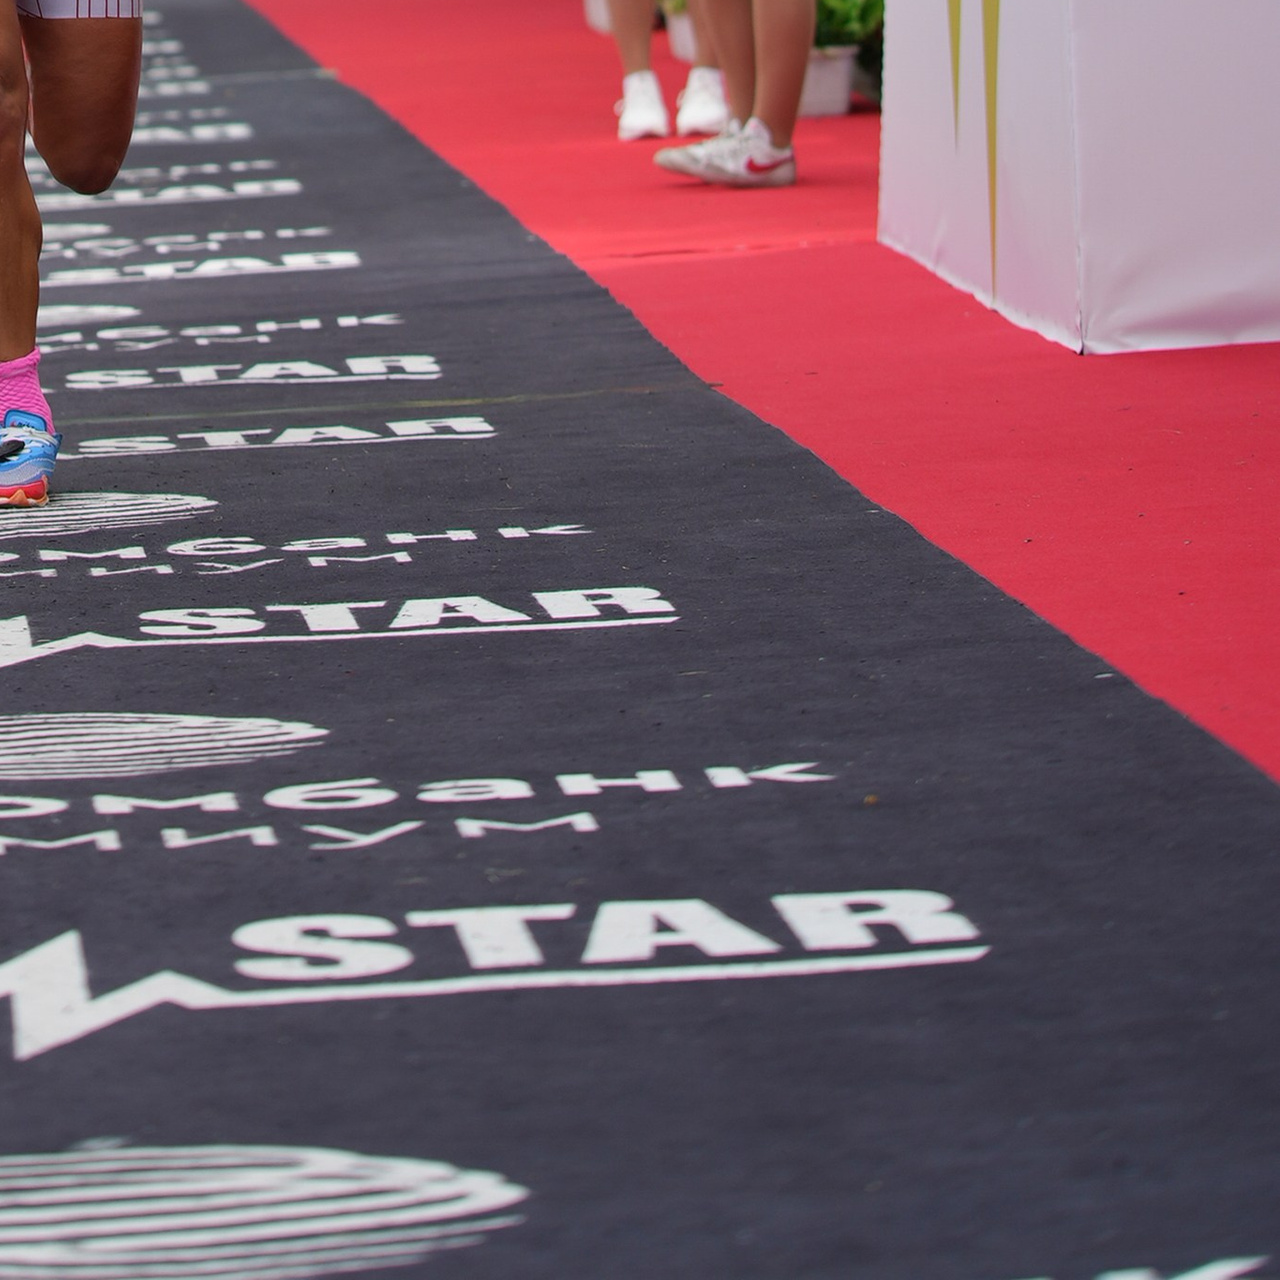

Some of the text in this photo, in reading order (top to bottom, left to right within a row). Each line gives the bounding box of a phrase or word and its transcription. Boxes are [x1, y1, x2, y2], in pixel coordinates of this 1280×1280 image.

[65, 354, 442, 389] STAR
[78, 416, 496, 453] STAR
[138, 586, 677, 636] STAR
[230, 888, 983, 981] STAR
